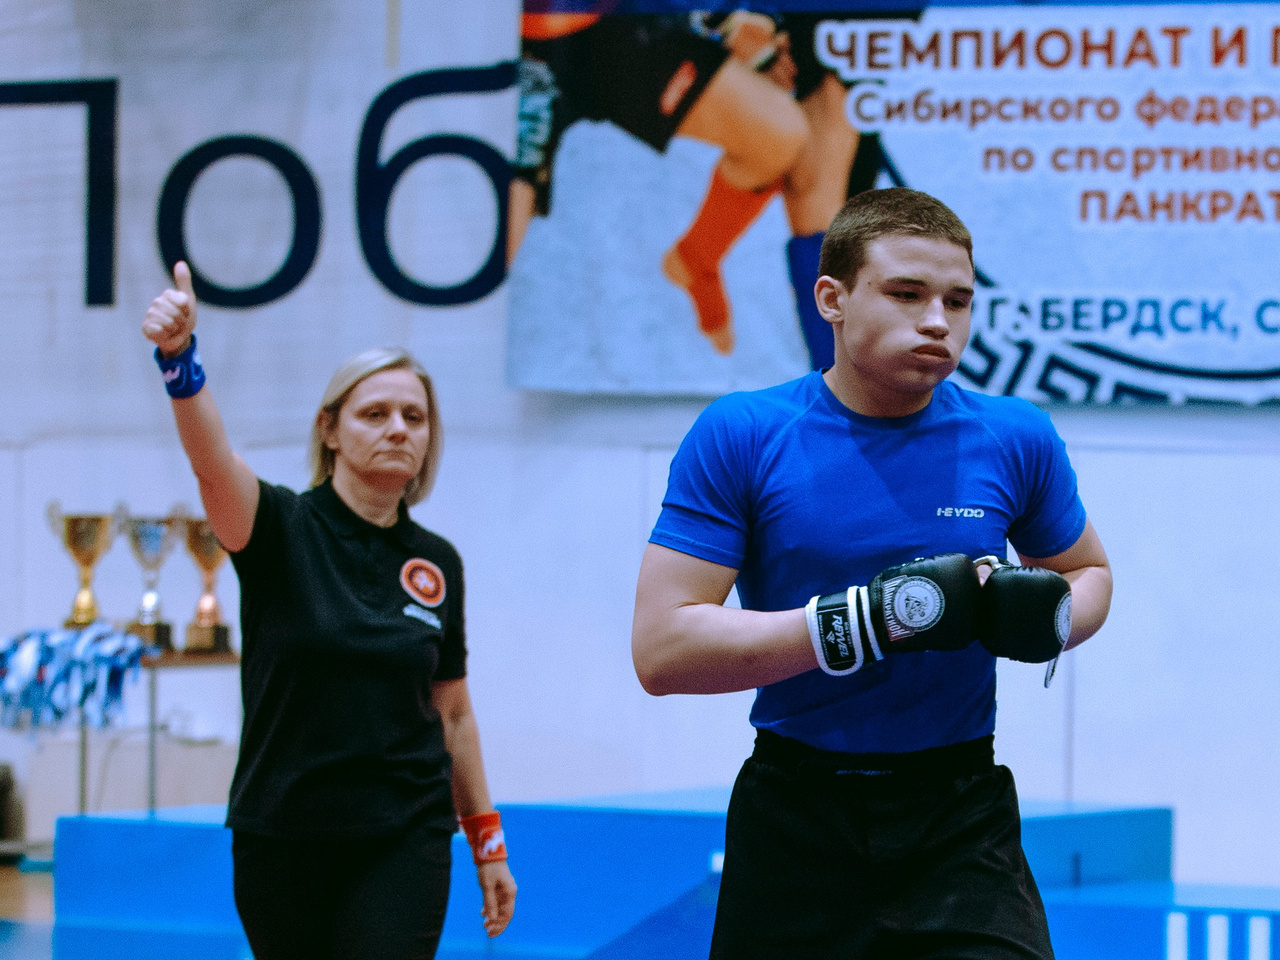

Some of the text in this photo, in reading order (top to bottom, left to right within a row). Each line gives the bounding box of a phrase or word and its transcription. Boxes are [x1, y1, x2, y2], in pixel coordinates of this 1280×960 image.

[826, 26, 1190, 72] ЧЕМПИОНАТ
[1210, 26, 1246, 68] И
[852, 88, 1121, 130] Сибирского
[983, 144, 1034, 171] по
[1041, 297, 1240, 340] БЕРДСК,
